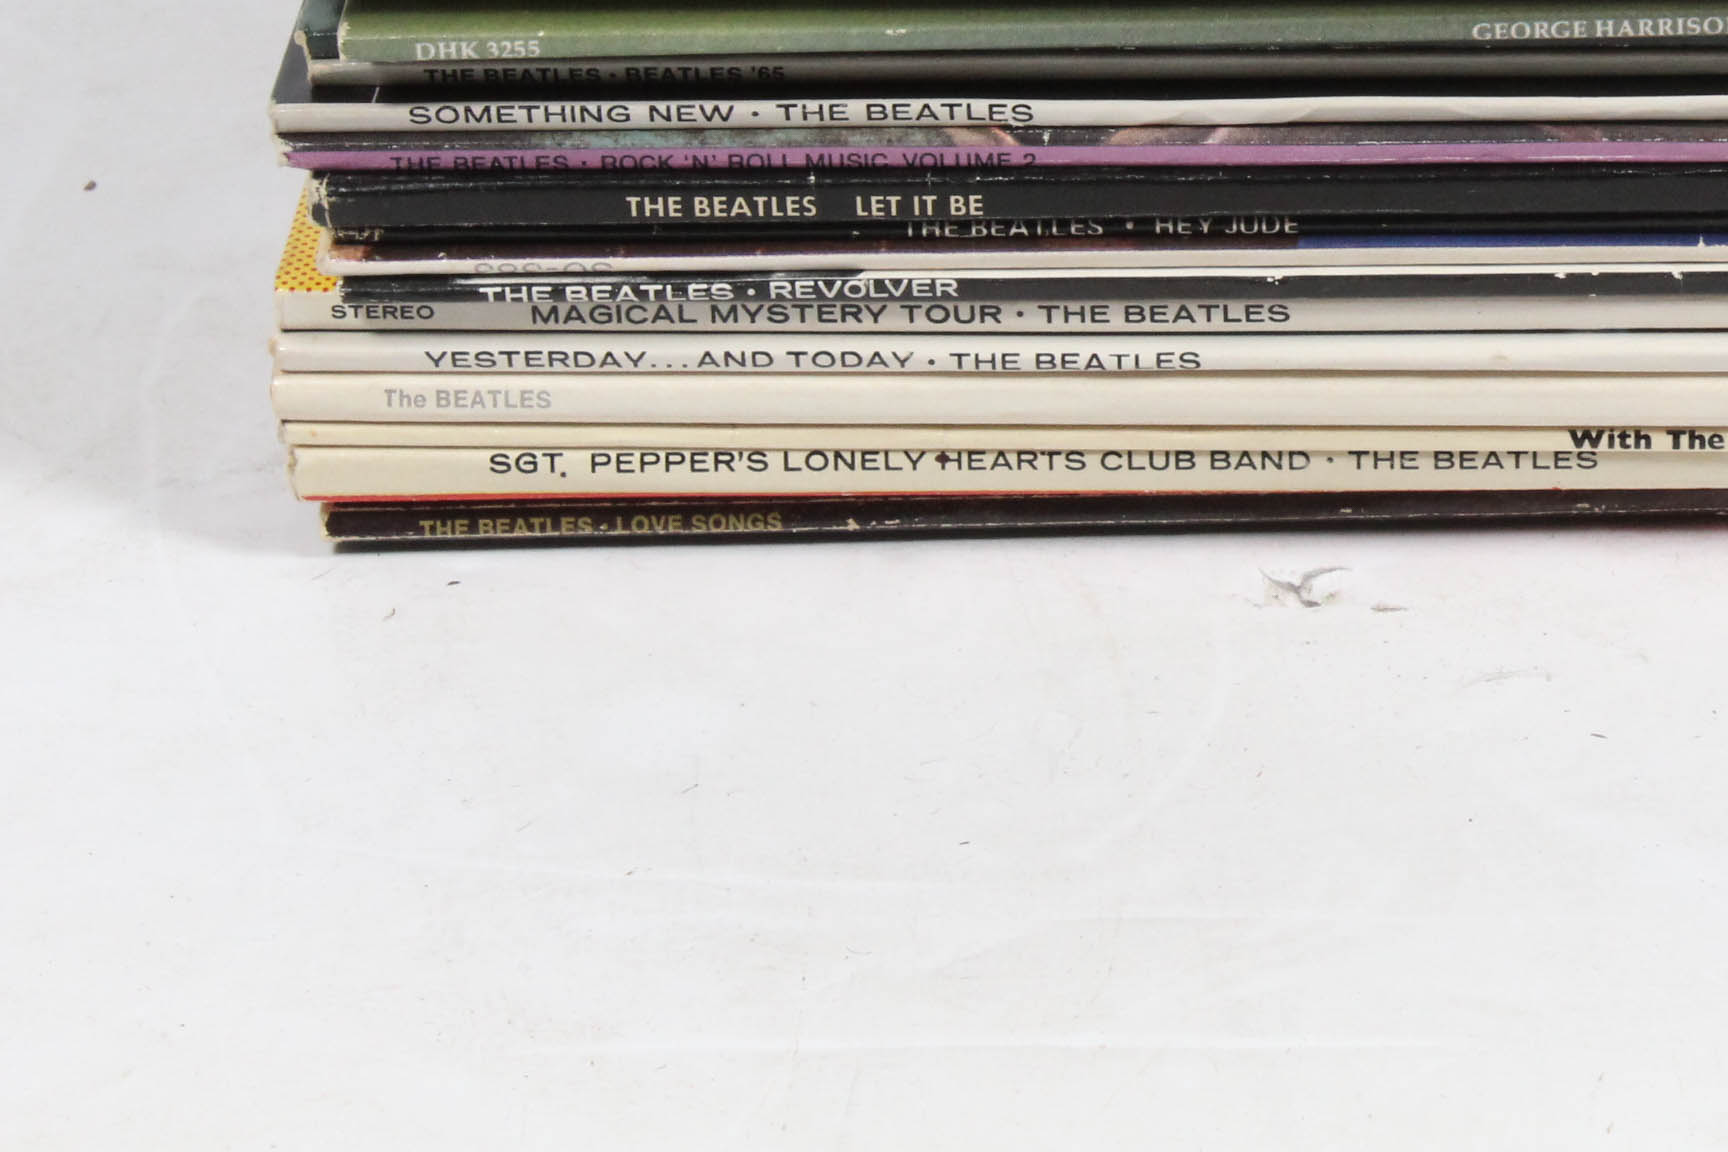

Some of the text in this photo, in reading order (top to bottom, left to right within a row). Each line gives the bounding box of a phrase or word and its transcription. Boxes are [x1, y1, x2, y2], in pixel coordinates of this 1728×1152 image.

[1471, 20, 1588, 41] GEORGE
[415, 40, 541, 61] DHK 3255
[424, 64, 786, 84] THE BEATLES BEATLES '65
[409, 103, 1034, 126] SOMETHING NEW THE BEATLES
[389, 157, 443, 169] THE
[452, 155, 569, 169] BEATLES
[600, 154, 674, 169] ROCK
[727, 153, 788, 168] ROLL
[804, 152, 888, 168] MUSIC
[901, 152, 1012, 167] VOLUME
[626, 194, 984, 218] THE BEATLES LET IT BE
[905, 217, 1300, 237] THE BEATLES HEY JUDE
[479, 279, 959, 302] THE BEATLES REVOLVER
[331, 304, 1290, 325] STEREO MAGICAL MYSTERY TOUR THE BEATLES
[787, 351, 914, 368] TODAY
[949, 353, 1021, 370] THE
[1034, 352, 1201, 369] BEATLES
[384, 389, 552, 409] The BEATLES
[1569, 428, 1652, 450] With
[1665, 429, 1725, 450] The
[489, 450, 1600, 477] SGT. PEPPER'S LONELY HEARTS CLUB BAND THE BEATLES
[419, 512, 782, 536] THE BEATLES LOVE SONGS
